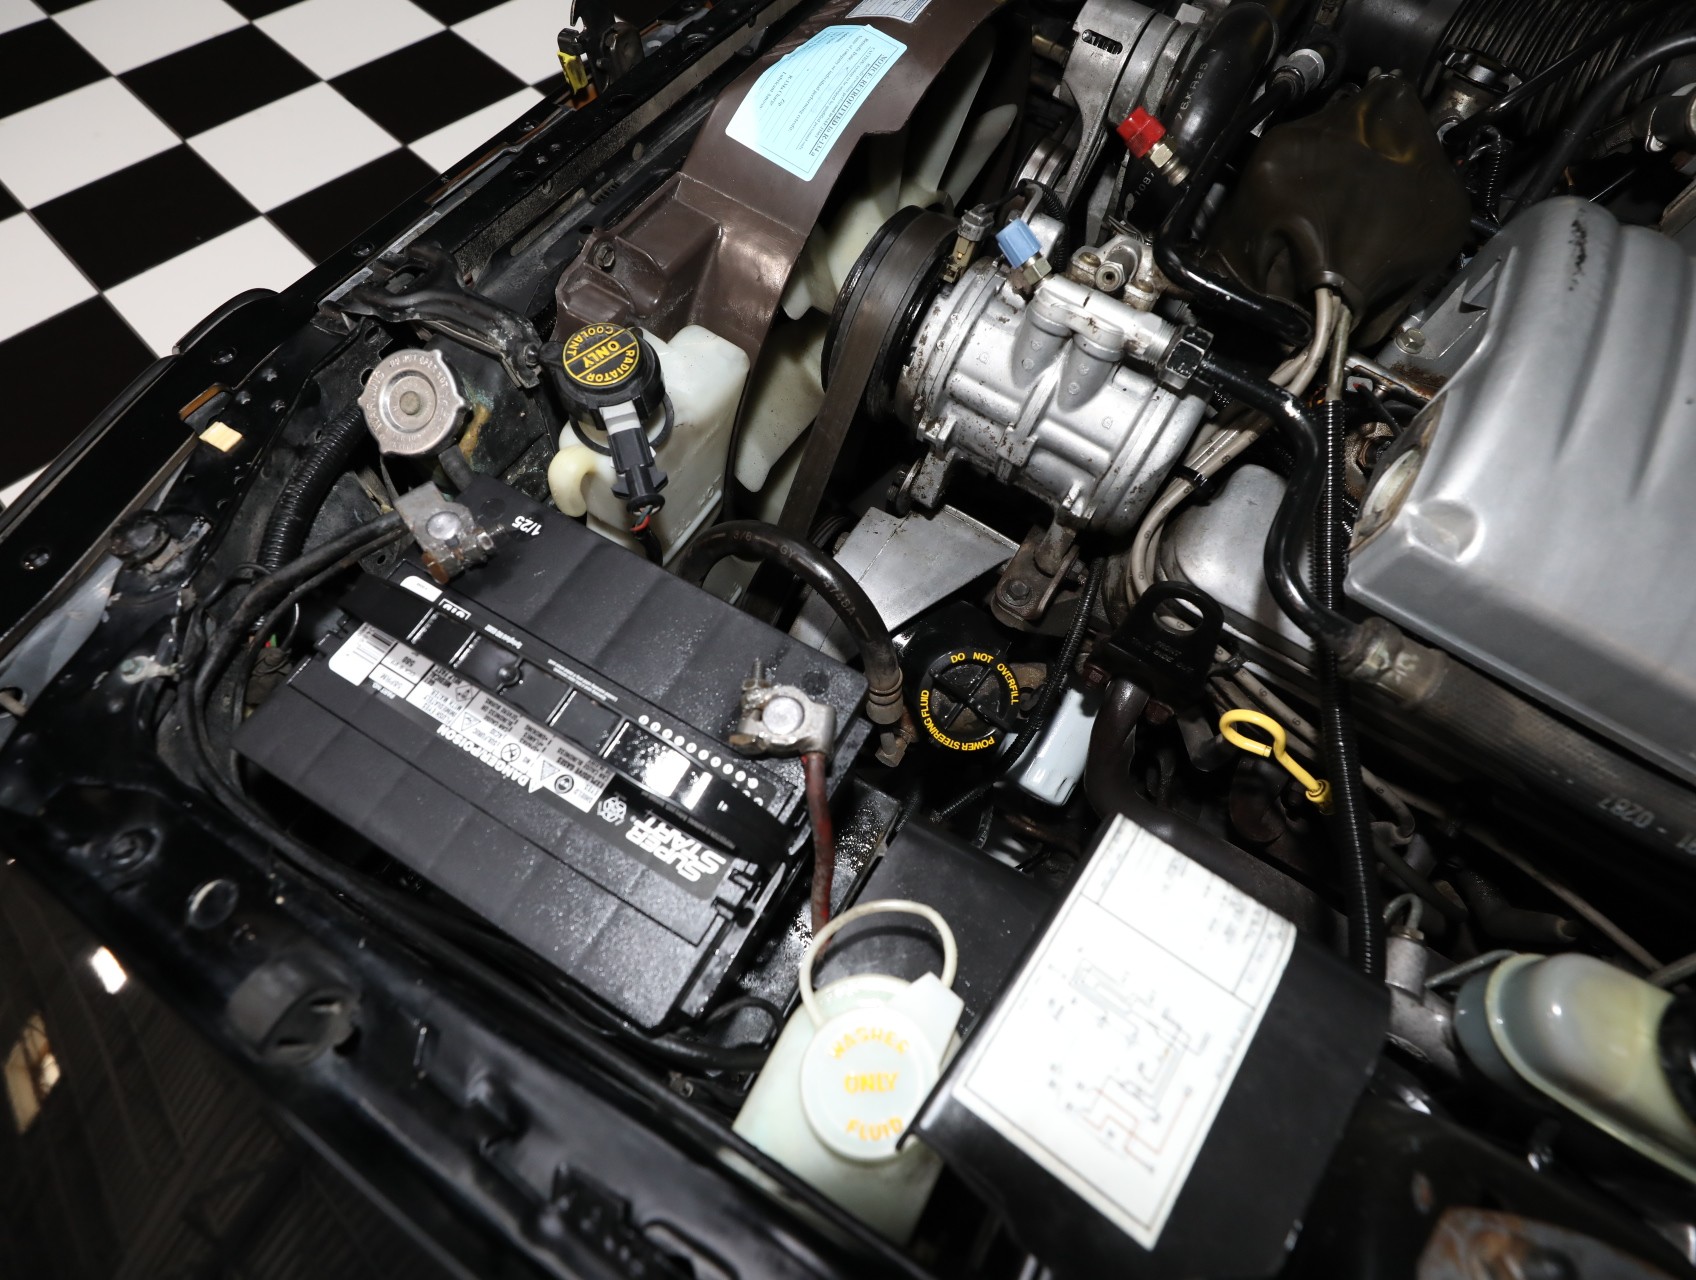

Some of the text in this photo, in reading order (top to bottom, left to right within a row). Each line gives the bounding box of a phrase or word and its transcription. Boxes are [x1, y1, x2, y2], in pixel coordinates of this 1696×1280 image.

[863, 54, 887, 80] NOTICE:
[830, 78, 867, 126] RETROFITTED
[567, 325, 614, 356] COOLANT
[583, 340, 620, 369] ONLY
[586, 349, 636, 383] RADIATOR
[512, 515, 542, 534] 1/25
[950, 652, 1020, 706] DO NOT OVERFILL
[920, 689, 995, 751] POWER STEERING FLUID
[435, 723, 530, 786] DANGER/POISON
[625, 829, 705, 880] SUPER
[631, 815, 726, 873] START
[843, 1071, 900, 1095] ONLY
[846, 1115, 904, 1142] FLUID
